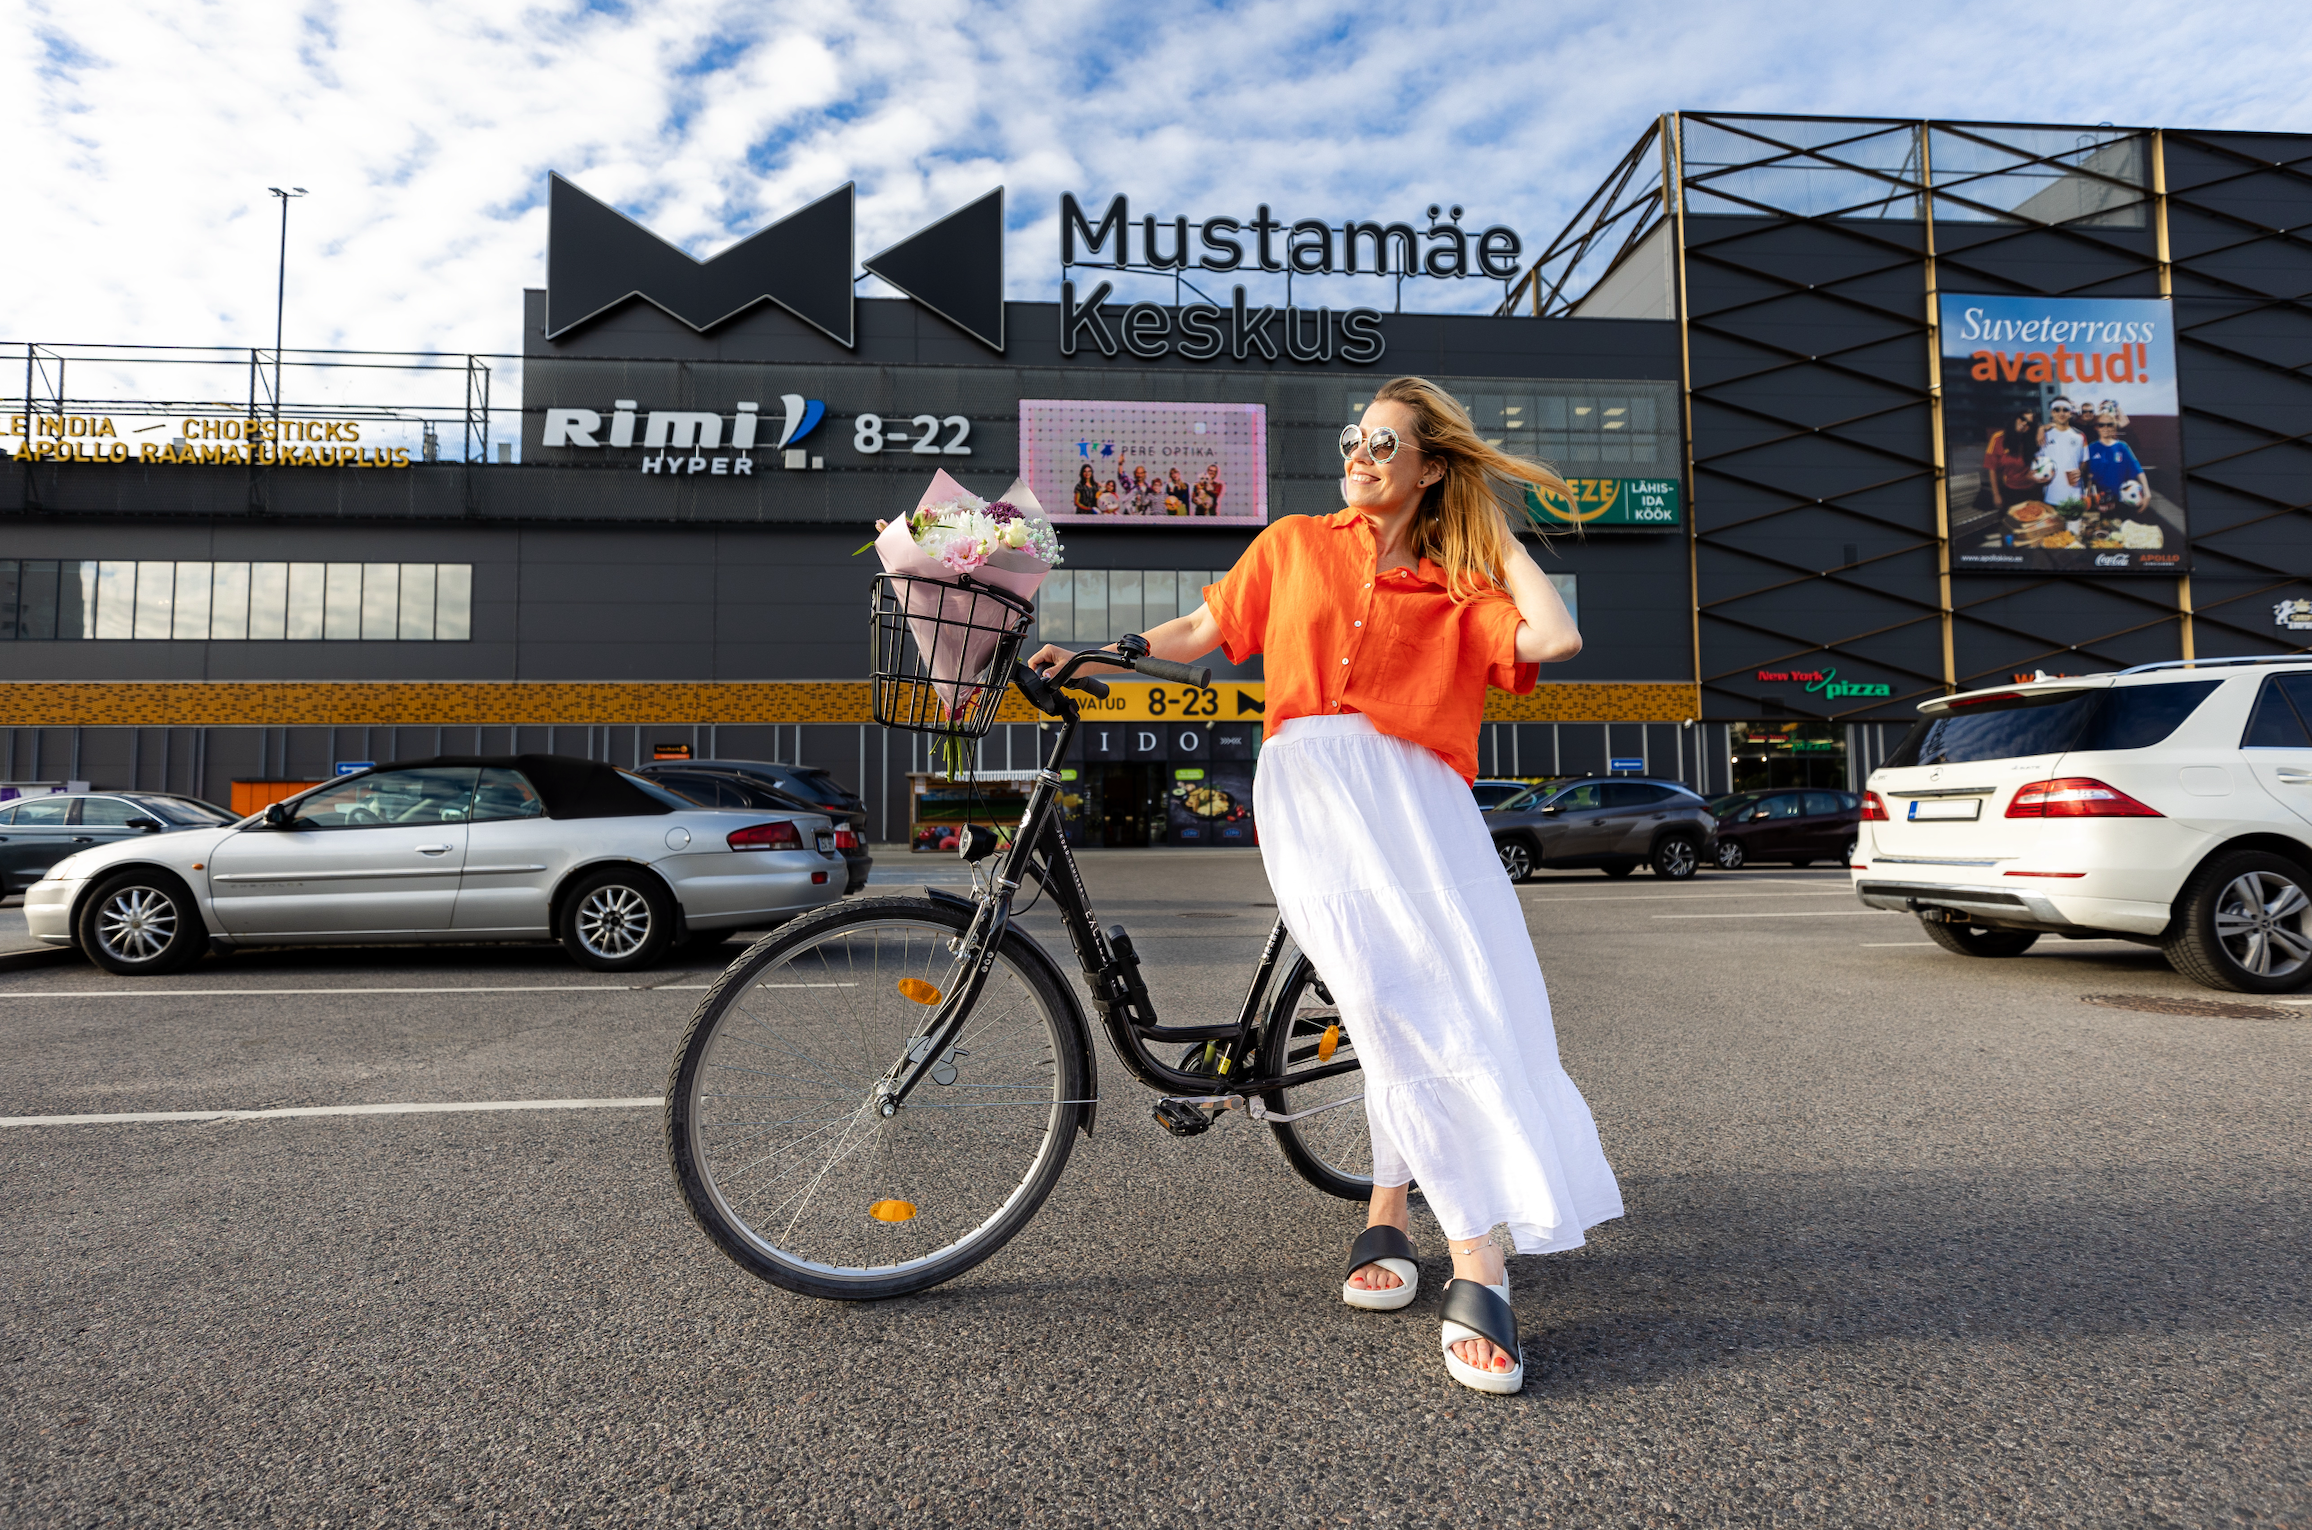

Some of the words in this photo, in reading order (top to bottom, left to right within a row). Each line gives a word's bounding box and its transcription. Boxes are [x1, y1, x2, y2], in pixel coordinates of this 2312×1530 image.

[1060, 191, 1522, 279] Mustamäe
[1060, 280, 1386, 363] Keskus
[1960, 307, 2155, 343] Suveterrass
[1971, 343, 2149, 384] avatud!
[37, 416, 117, 437] INDIA
[182, 418, 360, 441] CHOPSTICKS
[543, 399, 758, 449] Rimi
[853, 413, 972, 455] 8-22
[13, 441, 129, 462] APOLLO
[139, 442, 410, 467] RAAMATUKAUPLUS
[1122, 446, 1155, 457] PERE
[1162, 446, 1215, 457] OPTIKA
[641, 456, 753, 475] HYPER
[1642, 496, 1664, 506] IDA
[2140, 554, 2179, 562] APOLLO
[1758, 671, 1789, 680] New
[1791, 671, 1823, 681] York
[1079, 697, 1126, 710] VATUD
[1149, 688, 1218, 715] 8-23
[1826, 680, 1890, 699] pizza
[1055, 731, 1199, 751] IDO
